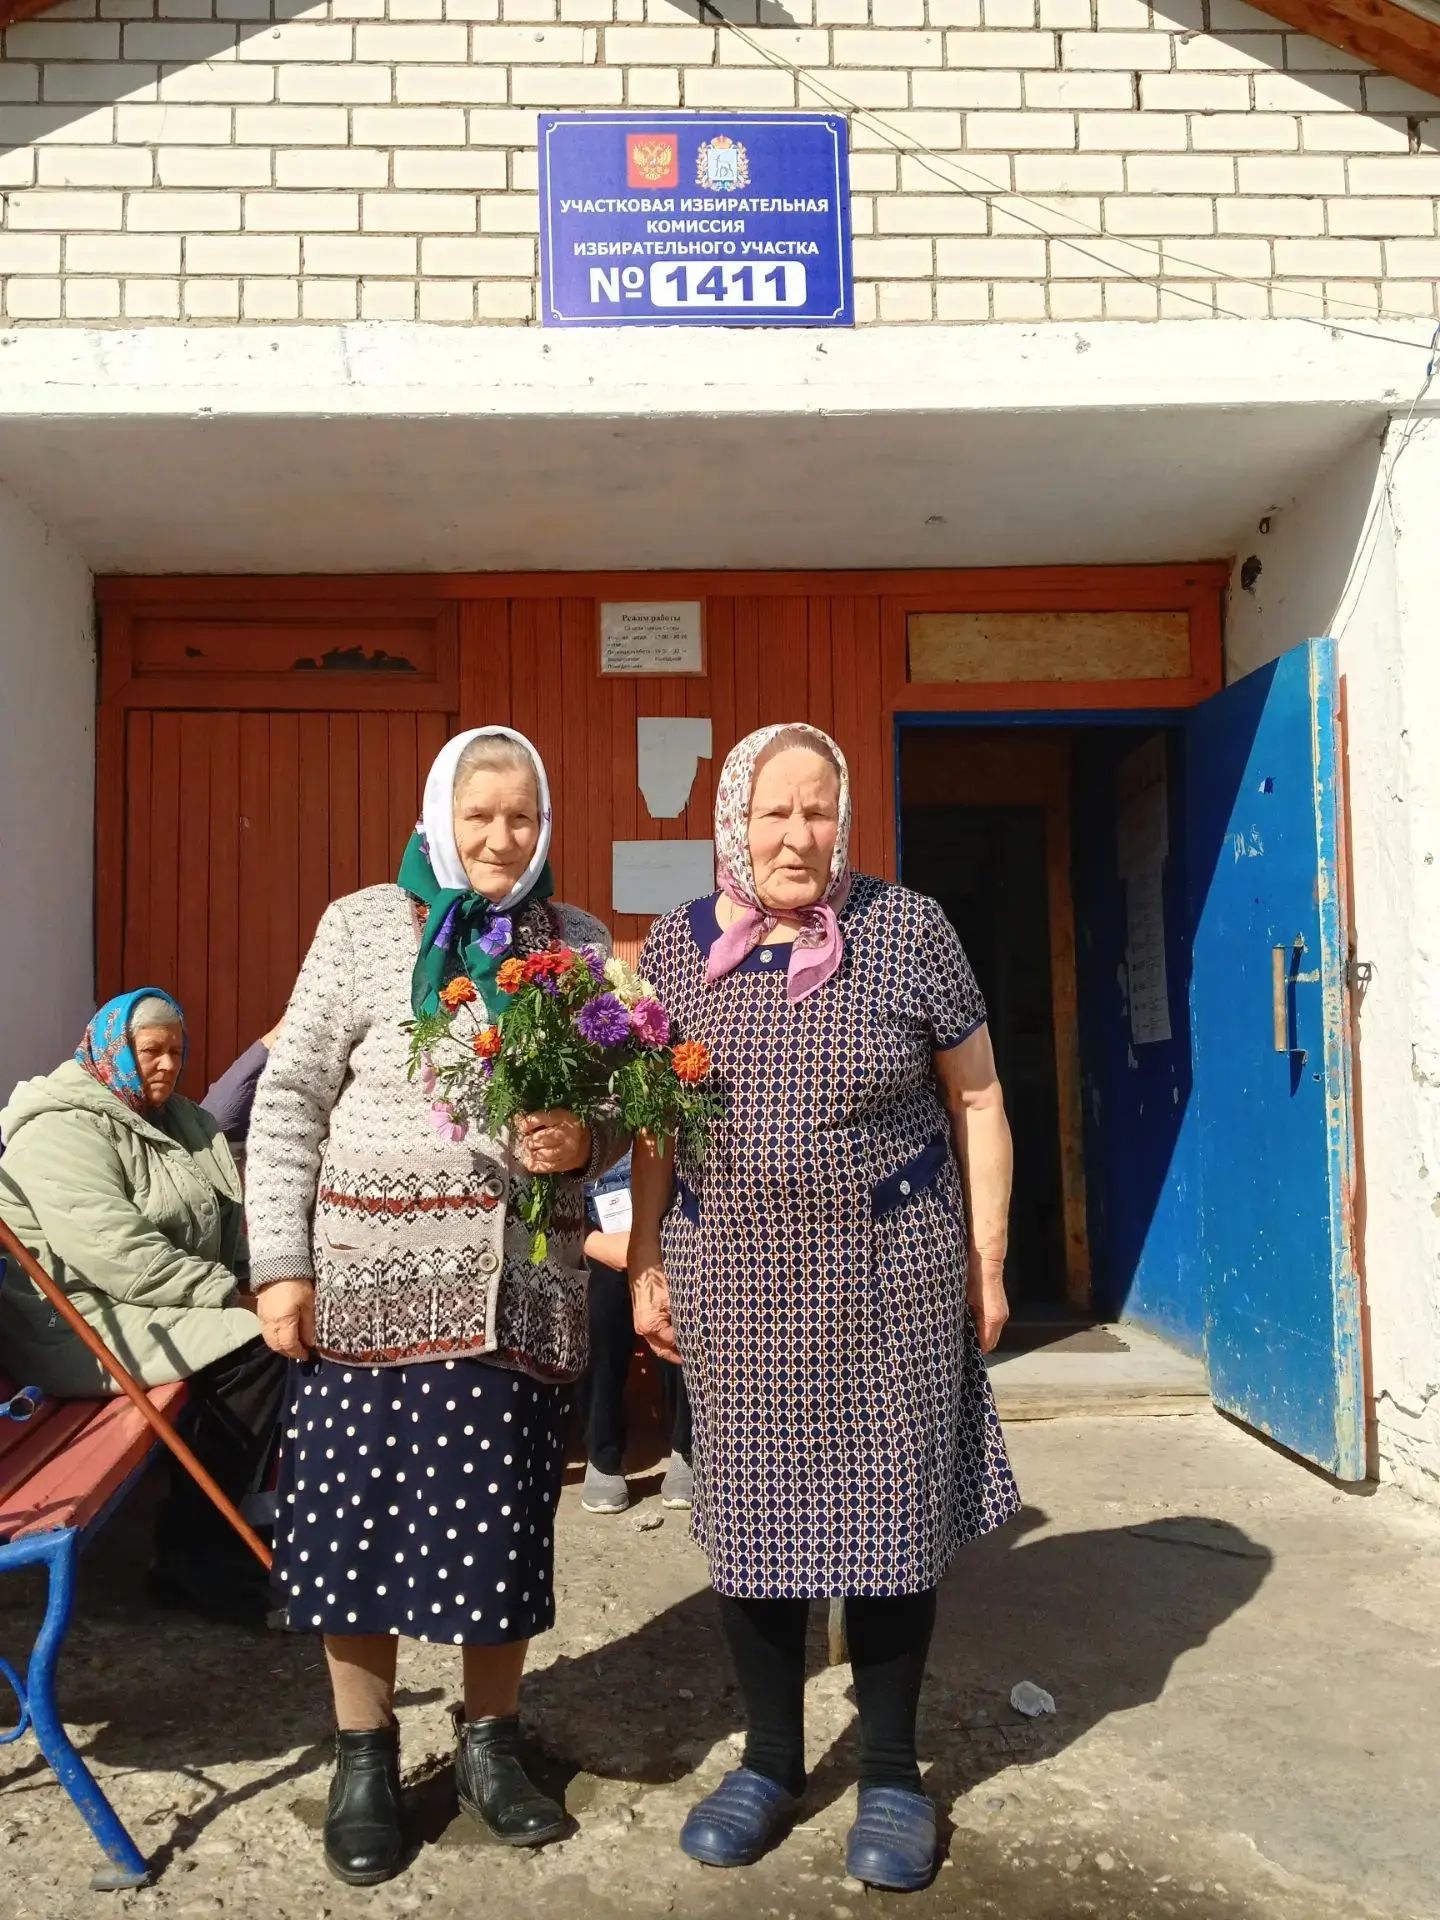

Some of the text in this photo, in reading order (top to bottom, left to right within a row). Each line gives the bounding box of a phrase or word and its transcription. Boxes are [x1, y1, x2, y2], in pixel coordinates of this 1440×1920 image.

[560, 199, 828, 212] УЧАСТКОВАЯ ИЗБИРАТЕЛЬНАЯ
[647, 220, 744, 233] КОМИССИЯ
[574, 242, 818, 255] ИЗБИРАТЕЛЬНОГО УЧАСТКА
[666, 266, 786, 301] 1411
[651, 614, 680, 623] работы
